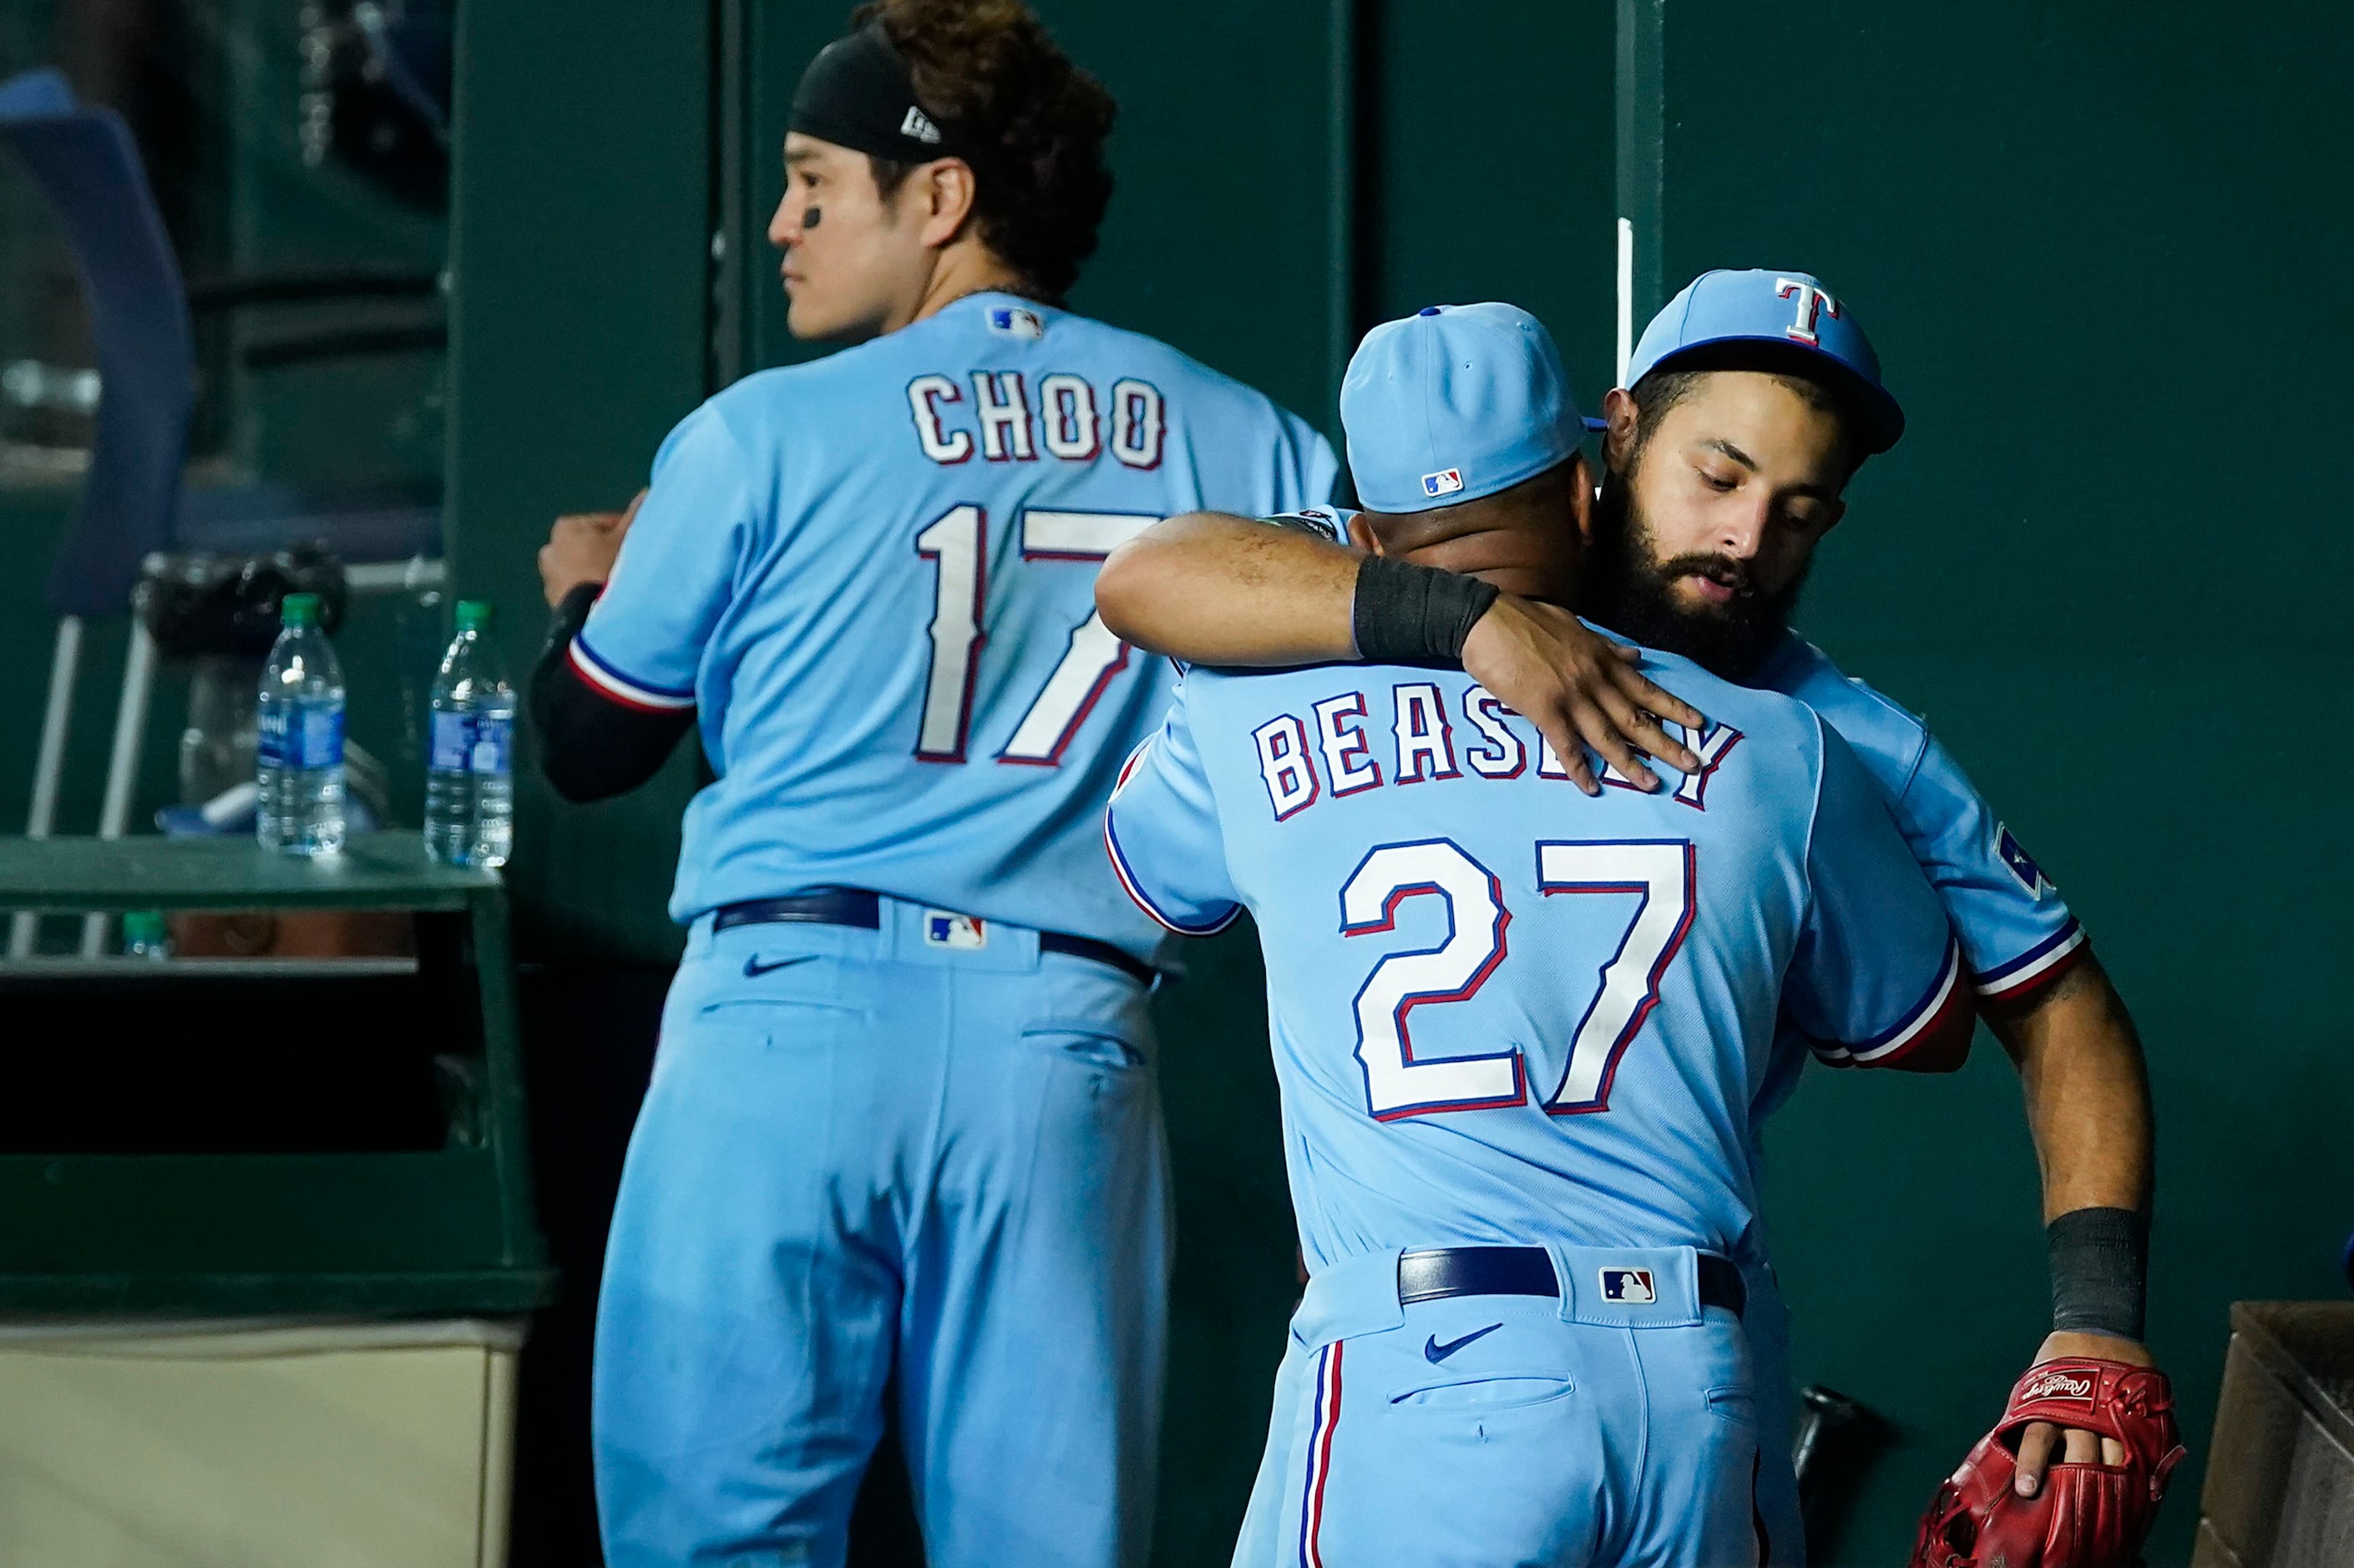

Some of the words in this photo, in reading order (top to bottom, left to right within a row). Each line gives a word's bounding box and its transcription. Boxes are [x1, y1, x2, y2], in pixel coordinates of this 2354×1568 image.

[1774, 276, 1839, 347] T
[906, 369, 1167, 471] CHOO
[913, 502, 1167, 767] 17
[1252, 682, 1745, 822] BEASY
[1338, 837, 1696, 1122] 27
